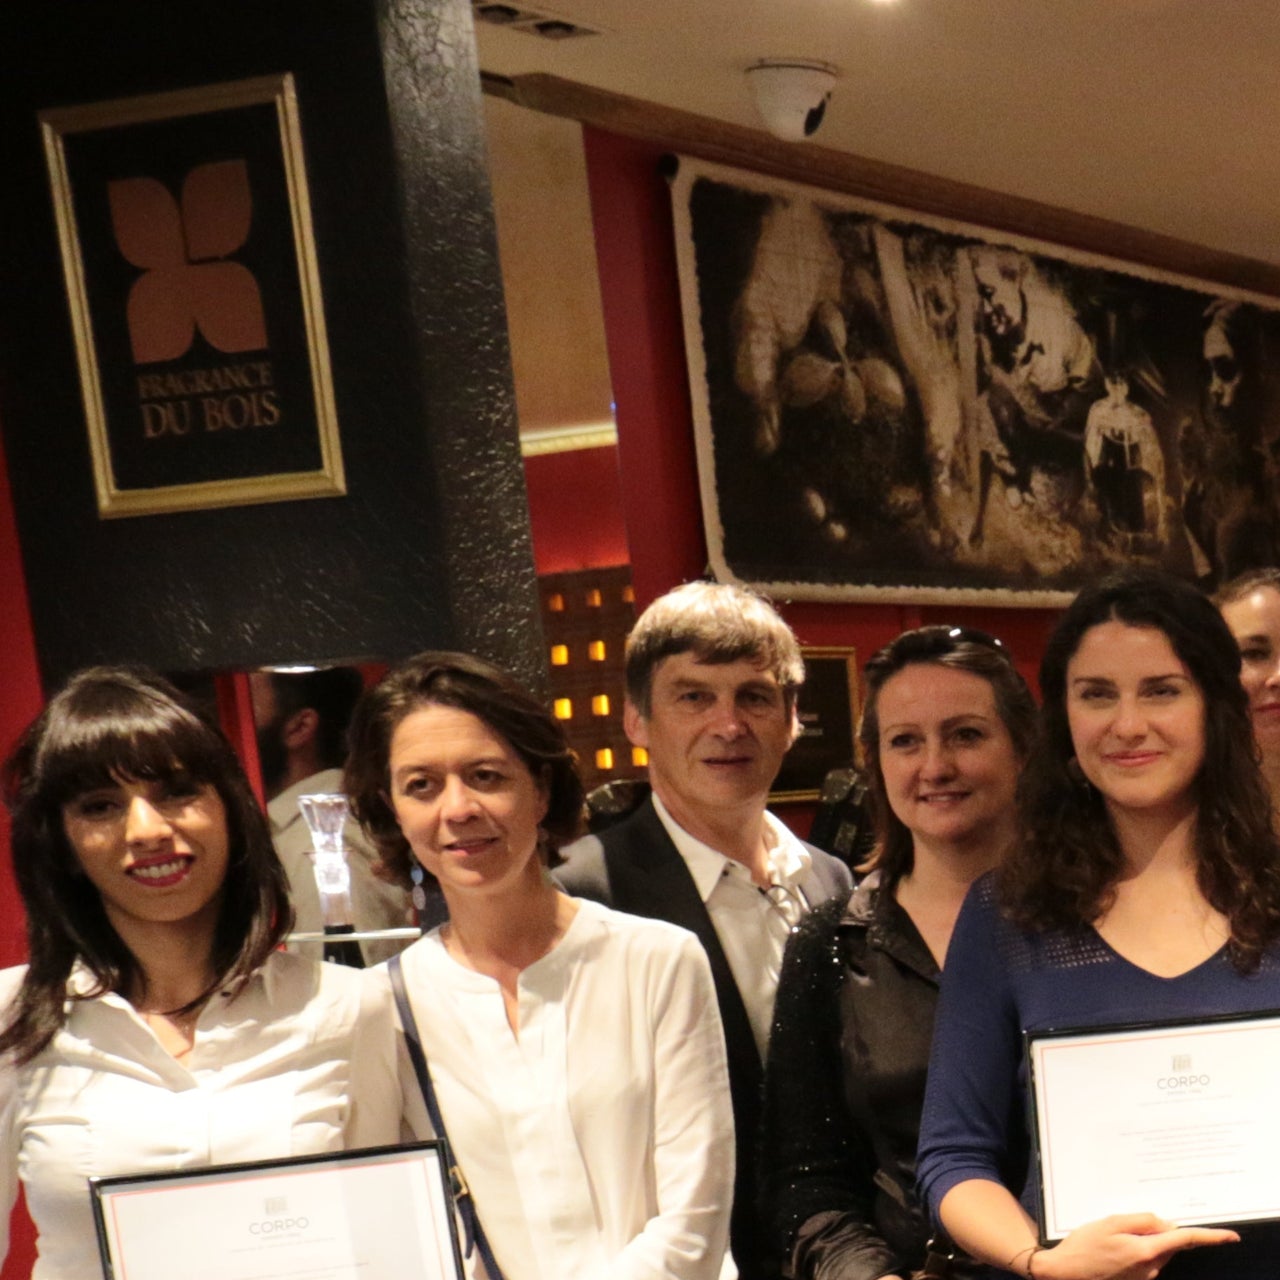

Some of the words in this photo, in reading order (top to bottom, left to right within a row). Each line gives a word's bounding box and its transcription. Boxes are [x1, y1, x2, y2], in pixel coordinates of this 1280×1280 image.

[137, 361, 273, 400] FRAGRANCE
[140, 401, 191, 438] DU
[202, 389, 281, 432] BOIS
[1156, 1074, 1210, 1090] CORPO
[248, 1216, 310, 1235] CORPO
